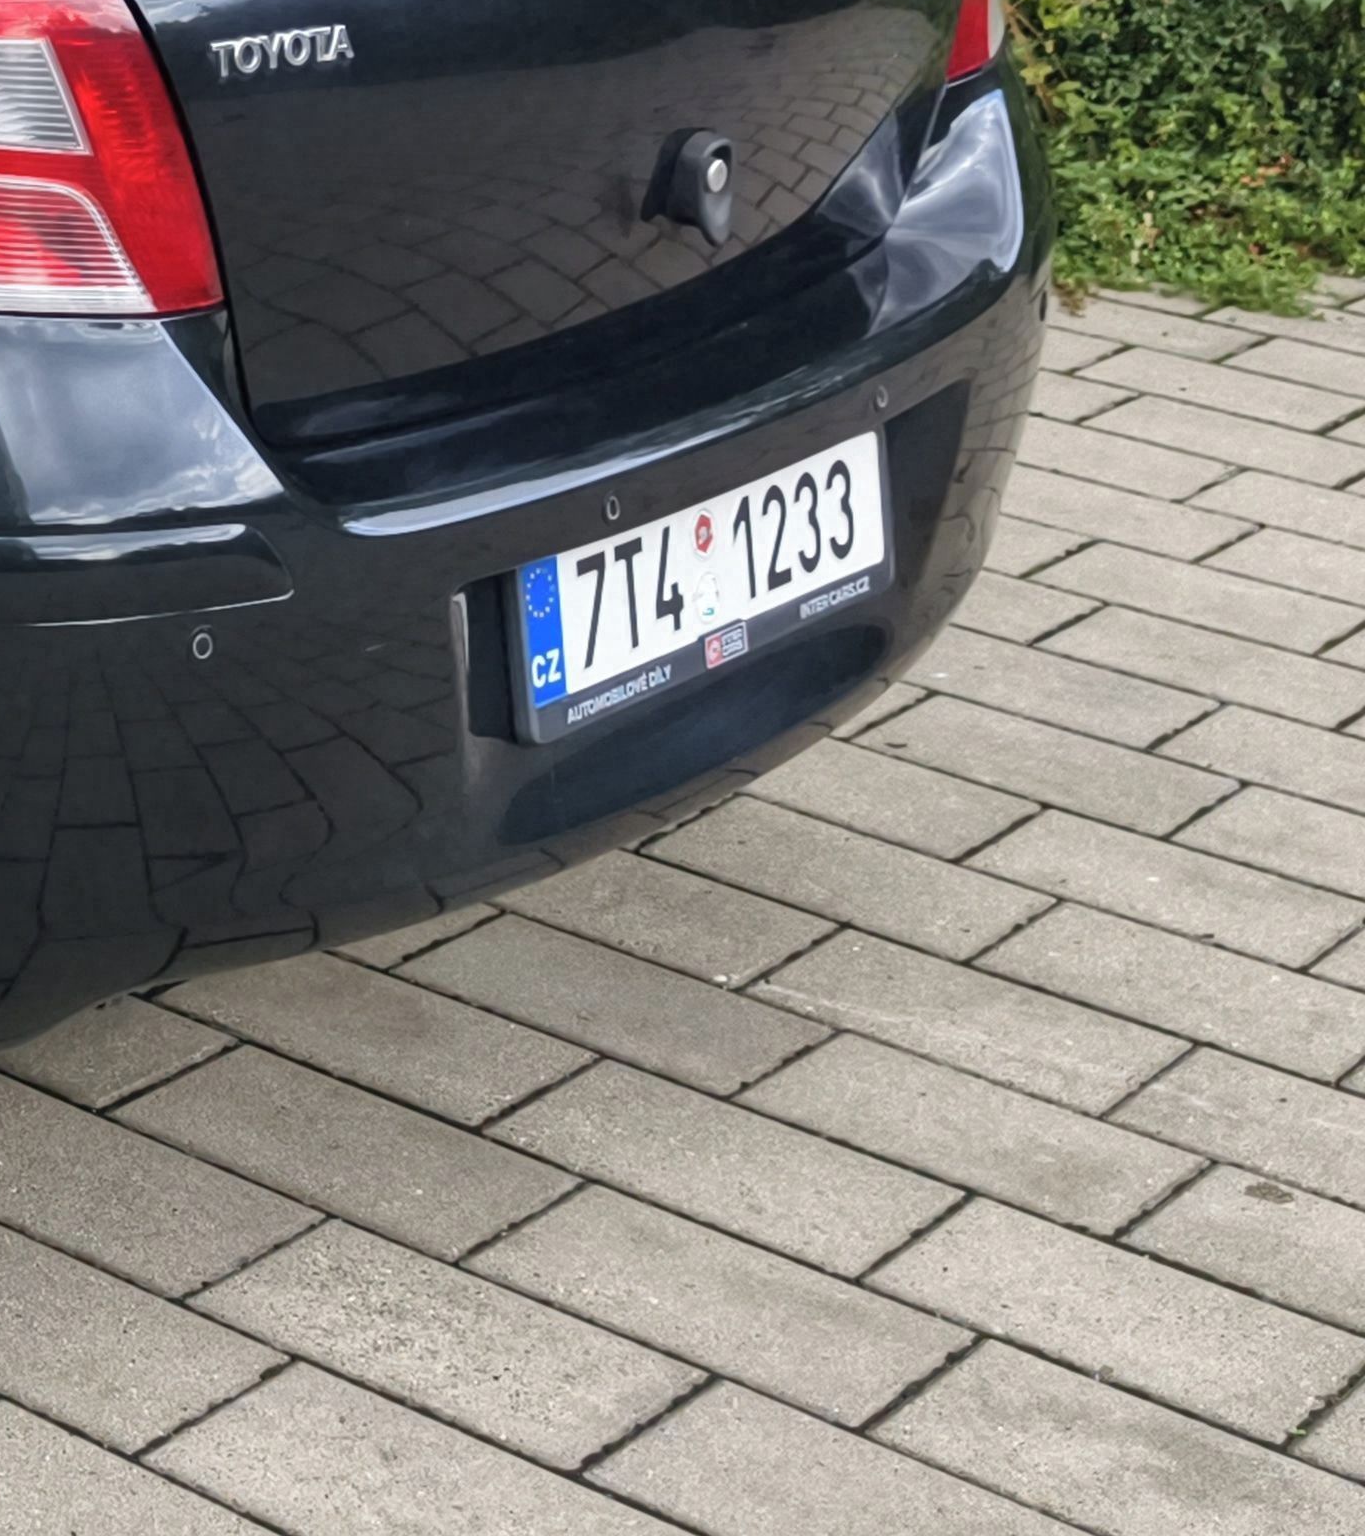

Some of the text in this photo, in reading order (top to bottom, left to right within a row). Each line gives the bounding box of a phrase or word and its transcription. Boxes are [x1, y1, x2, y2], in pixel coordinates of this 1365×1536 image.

[210, 24, 354, 78] TOYOTA
[576, 460, 854, 669] 7T4 1233
[532, 648, 562, 688] CZ
